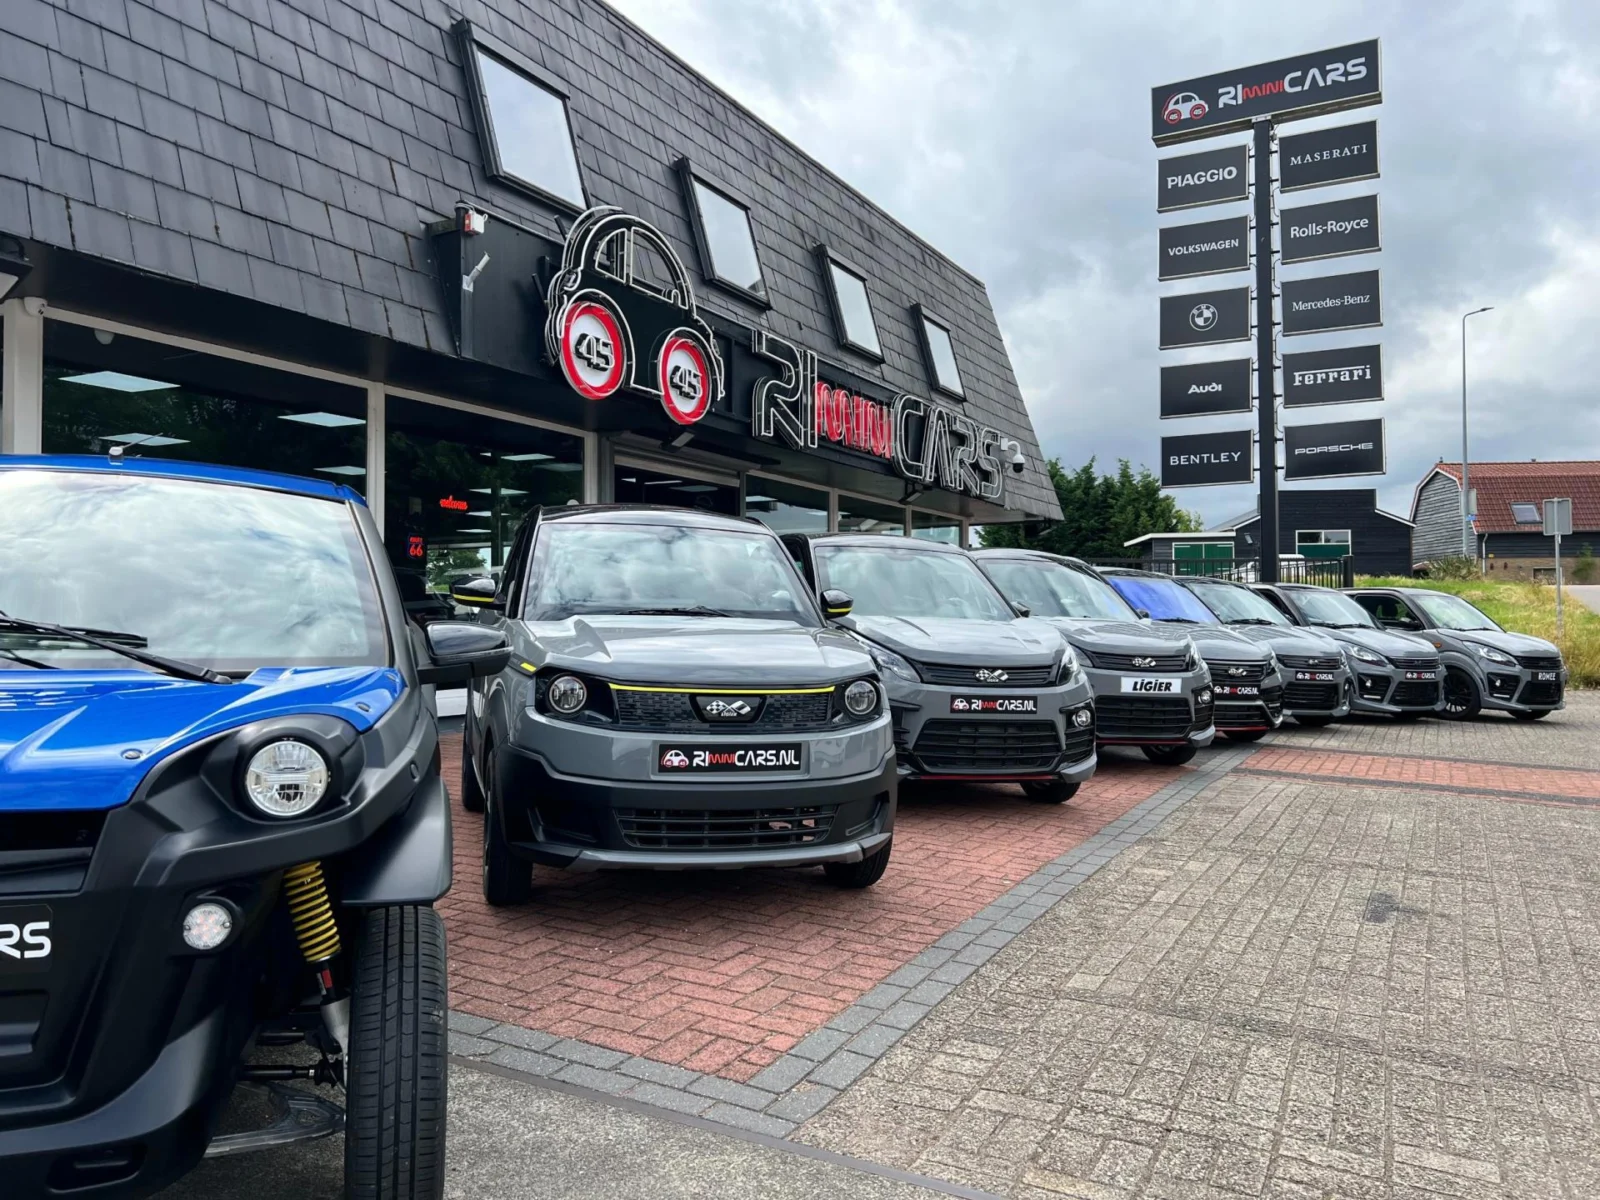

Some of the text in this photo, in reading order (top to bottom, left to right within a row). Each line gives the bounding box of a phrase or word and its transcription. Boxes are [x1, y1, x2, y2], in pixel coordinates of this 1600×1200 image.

[1289, 144, 1368, 166] MASERATI
[1166, 166, 1237, 189] PIAGGIO
[1290, 217, 1369, 239] Rolls-Royce
[1168, 238, 1239, 256] VOLKSWAGEN
[1292, 294, 1370, 312] Mercedes-Benz
[574, 332, 616, 372] 45
[669, 365, 703, 400] 45
[1293, 365, 1372, 386] Ferrari
[1187, 382, 1222, 394] Audi
[1294, 442, 1374, 455] PORSCHE
[1169, 452, 1241, 466] BENTLEY
[409, 544, 423, 557] 66
